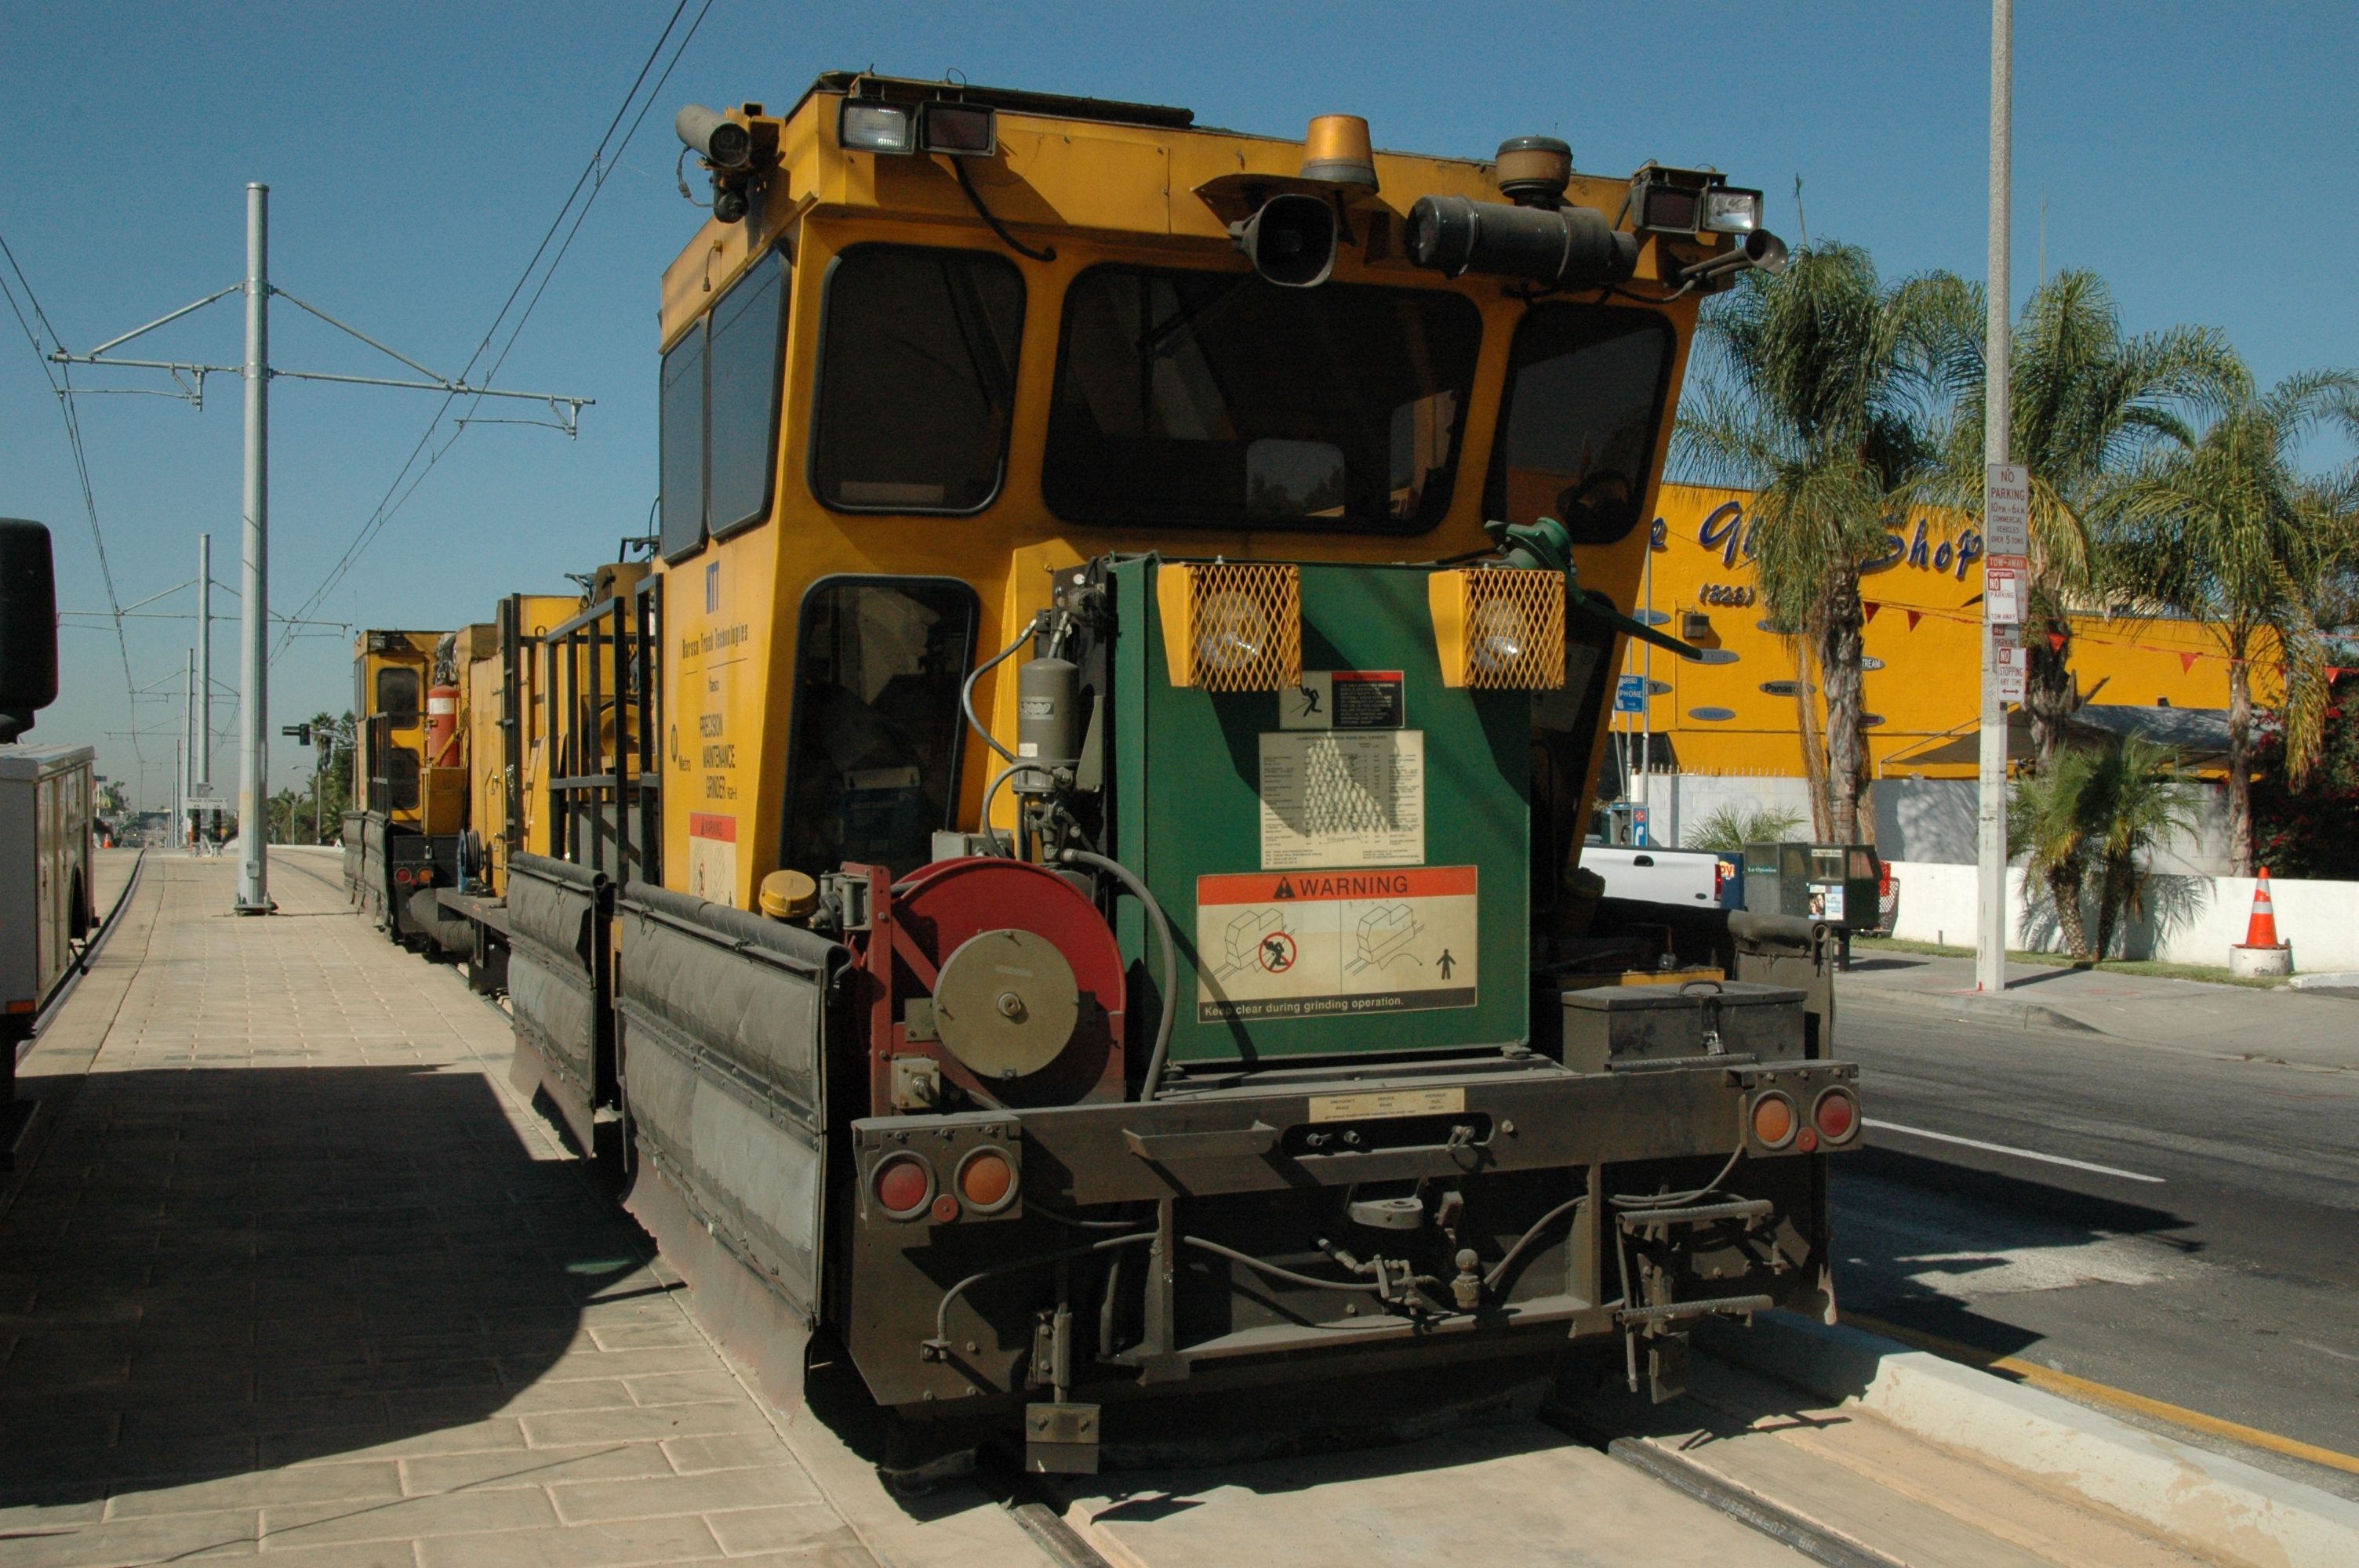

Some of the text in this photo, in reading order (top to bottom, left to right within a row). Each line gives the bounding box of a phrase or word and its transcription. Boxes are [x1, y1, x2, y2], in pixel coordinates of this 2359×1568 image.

[2001, 470, 2015, 483] NO
[1990, 487, 2025, 501] PARKING
[1992, 514, 2023, 524] COMMERCIAL
[1996, 525, 2019, 534] VEHICLES
[2006, 534, 2010, 545] 5
[2012, 536, 2024, 546] TONS
[1990, 557, 2024, 567] TOW-AWAY
[1989, 578, 1999, 590] NO
[1699, 582, 1754, 606] (323)
[714, 622, 748, 649] Technologies
[1994, 638, 2017, 648] PARKING
[2000, 649, 2009, 663] NO
[1999, 666, 2023, 677] STOPPING
[1619, 689, 1644, 698] PHONE
[700, 713, 723, 738] PRECISION
[703, 744, 736, 769] MAINTENANCE
[707, 775, 726, 800] GRINDER
[1299, 875, 1408, 897] WARNING
[1205, 996, 1405, 1018] Keep clear during grinding operation.
